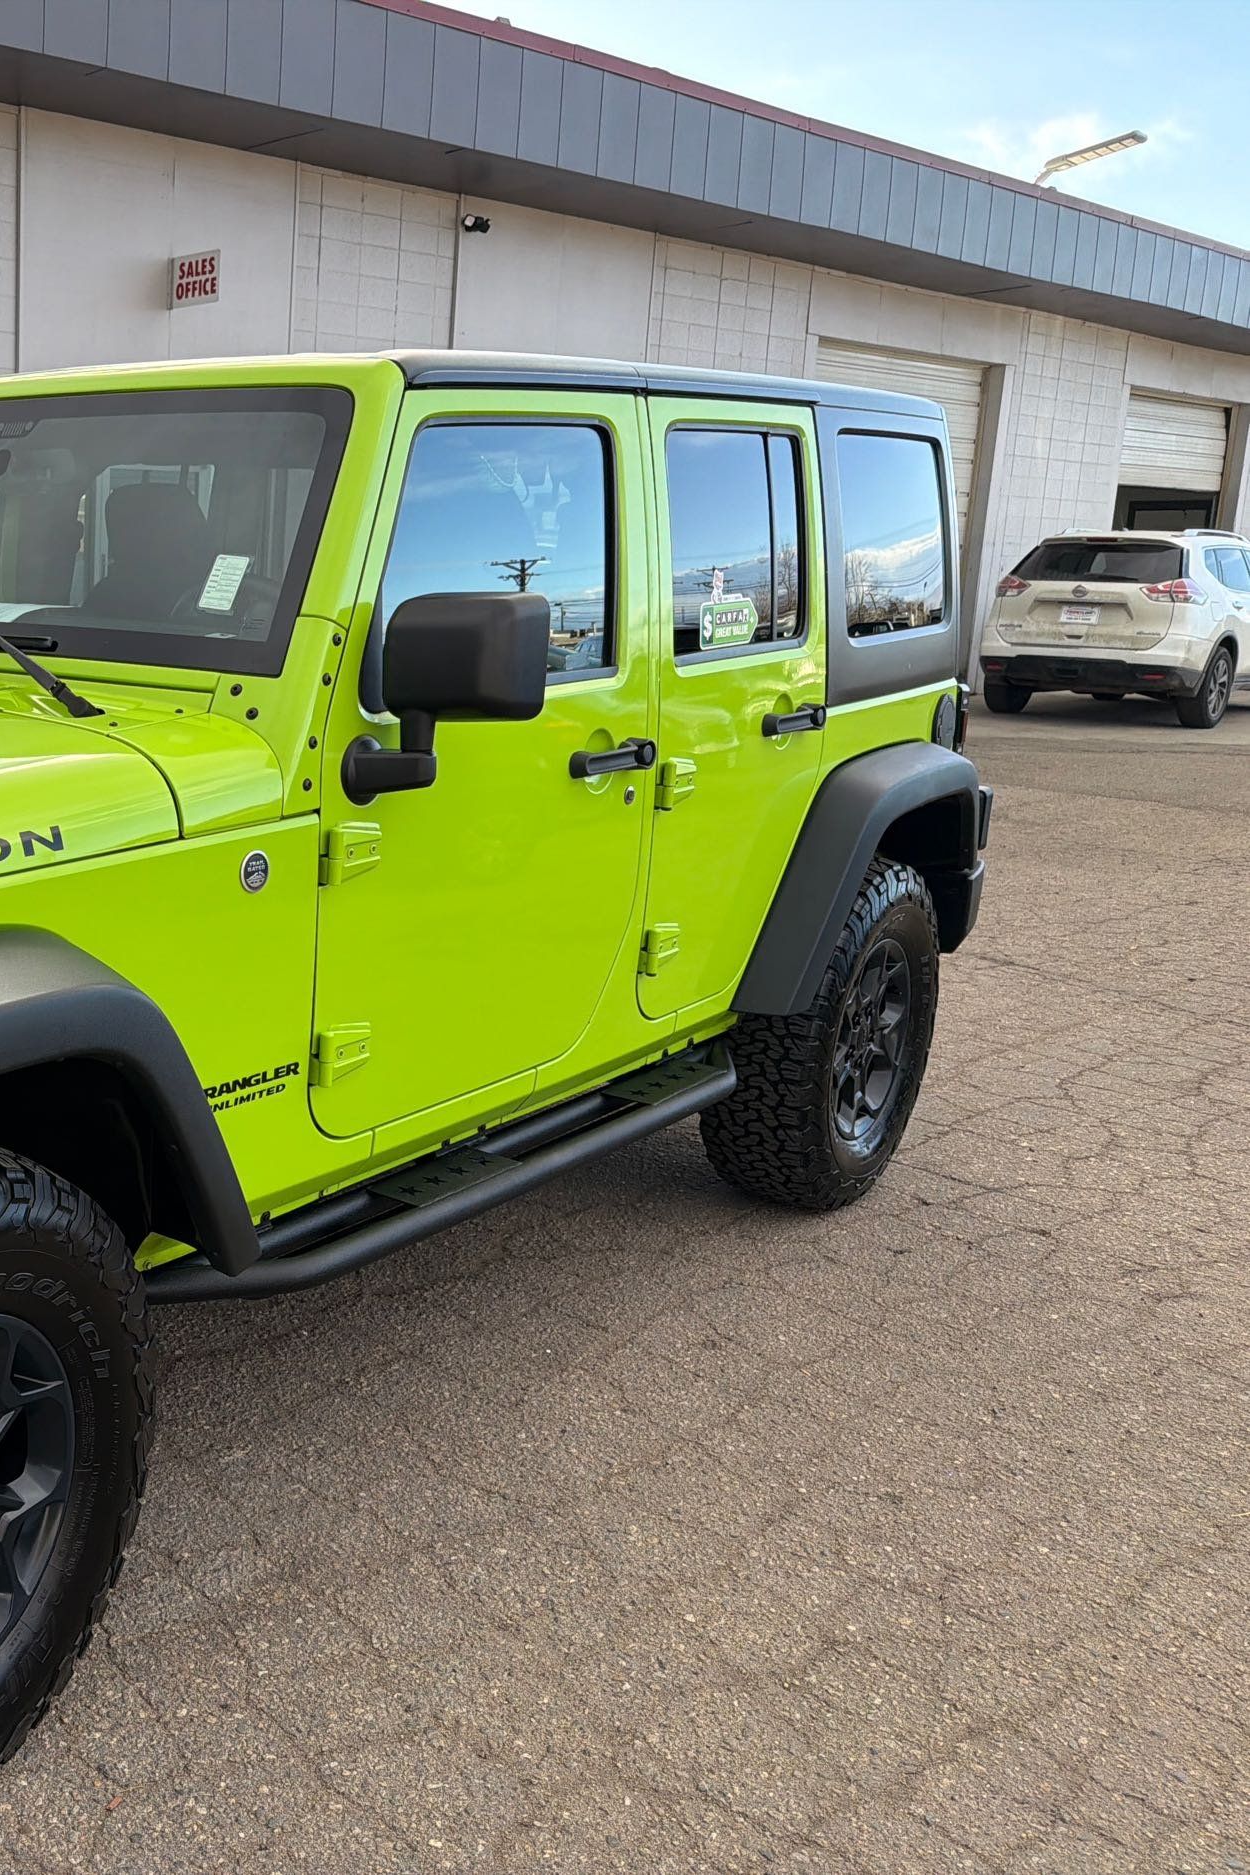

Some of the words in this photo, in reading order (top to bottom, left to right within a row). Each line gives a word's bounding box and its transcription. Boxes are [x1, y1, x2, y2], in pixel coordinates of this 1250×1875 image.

[178, 256, 215, 280] SALES
[176, 276, 217, 301] OFFICE
[204, 1062, 300, 1099] RANGLER
[210, 1083, 287, 1113] NLIMITED
